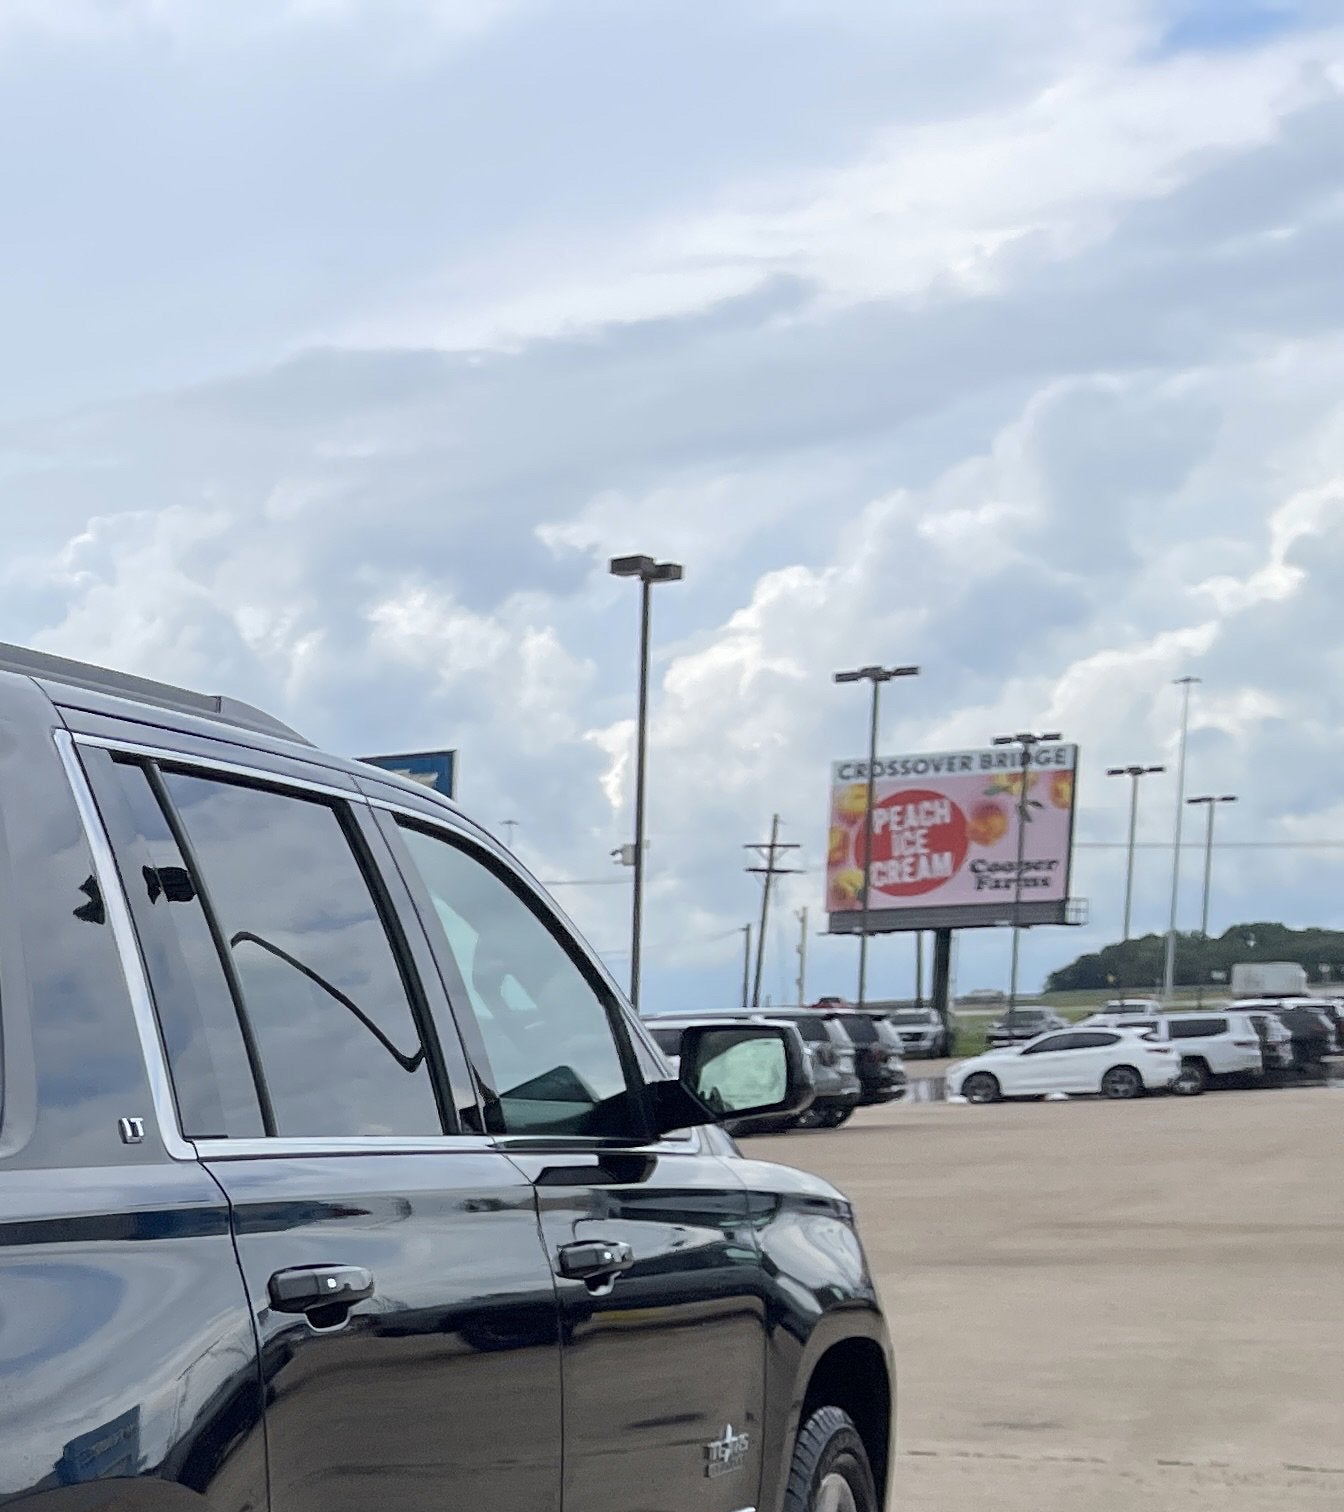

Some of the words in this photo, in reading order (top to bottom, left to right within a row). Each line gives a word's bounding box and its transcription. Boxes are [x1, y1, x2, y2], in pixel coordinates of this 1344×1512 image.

[837, 755, 974, 781] CROSSOVER
[979, 748, 1067, 771] BRIDGE
[872, 798, 952, 834] PEACH
[893, 828, 930, 856] ICE
[869, 852, 953, 886] CREAM
